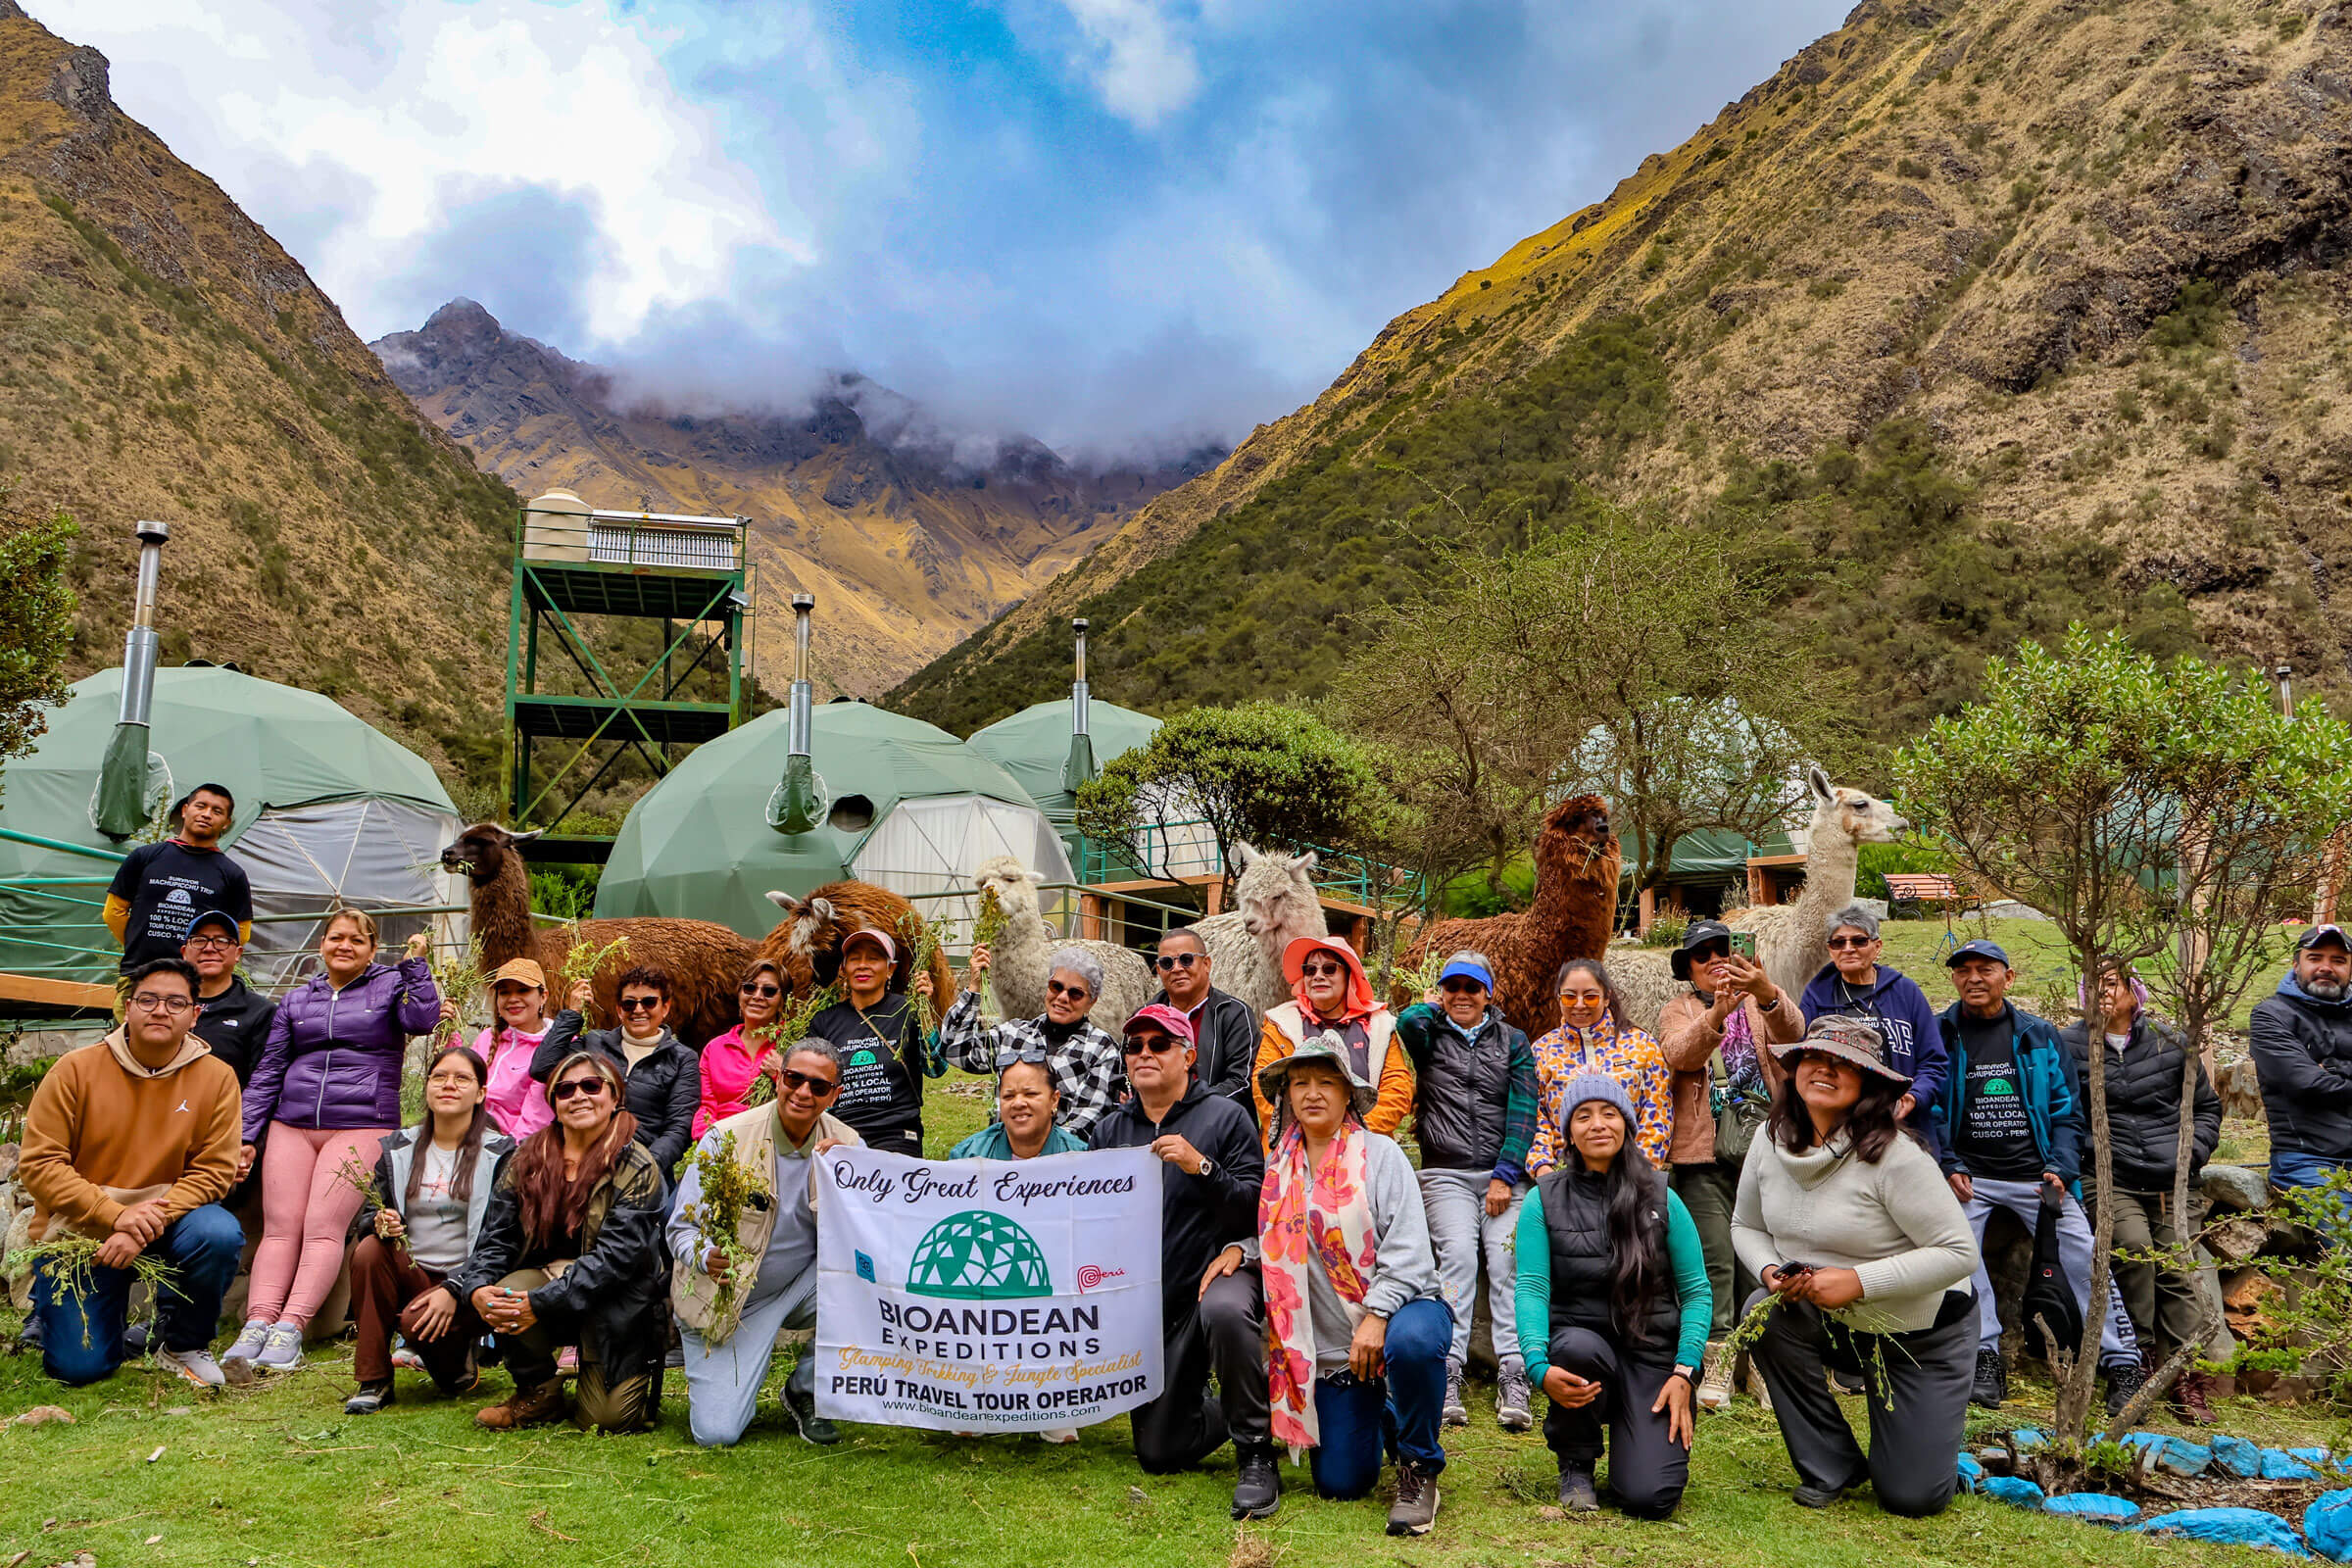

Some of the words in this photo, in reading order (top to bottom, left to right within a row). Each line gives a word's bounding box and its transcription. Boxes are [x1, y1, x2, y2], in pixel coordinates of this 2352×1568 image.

[149, 878, 199, 891] MACHUPICCHU
[158, 903, 196, 913] BIOANDEAN
[172, 916, 189, 925] LOC
[861, 1077, 891, 1087] LOCAL
[855, 1086, 891, 1097] OPERATOR
[1999, 1110, 2027, 1119] LOCAL
[1972, 1130, 2003, 1139] CUSCO
[834, 1160, 896, 1203] Only
[902, 1167, 978, 1203] Great
[994, 1171, 1134, 1206] Experiences
[878, 1298, 1099, 1335] BIOANDEAN
[882, 1327, 1100, 1360] EXPEDITIONS
[839, 1344, 916, 1376] Glamping
[982, 1363, 999, 1384] &
[1004, 1363, 1061, 1388] Jungle
[1064, 1349, 1144, 1384] Specialist
[831, 1374, 887, 1396] PERÚ
[895, 1379, 967, 1409] TRAVEL
[972, 1393, 1030, 1410] TOUR
[1037, 1374, 1147, 1408] OPERATOR
[882, 1400, 1101, 1423] www.bioandeanexpeditions.com
